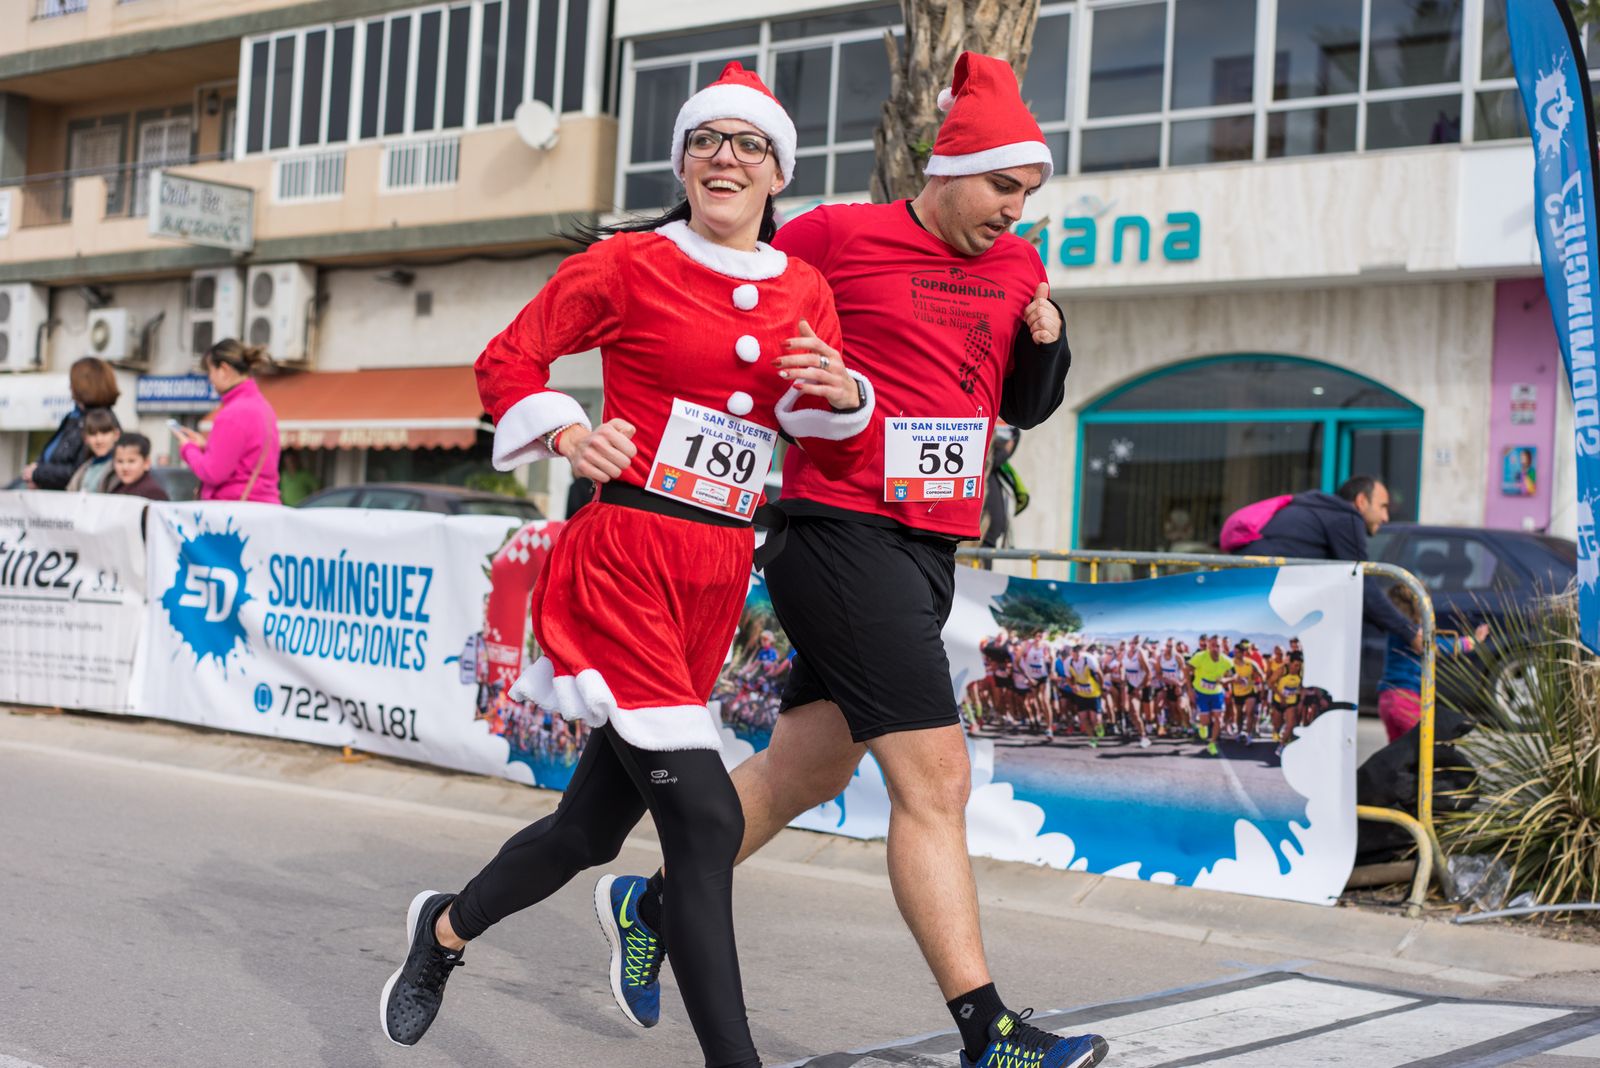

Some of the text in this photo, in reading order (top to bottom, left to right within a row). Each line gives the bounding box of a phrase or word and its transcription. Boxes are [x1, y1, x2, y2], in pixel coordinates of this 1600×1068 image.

[912, 310, 935, 324] Villa
[936, 315, 947, 326] de
[930, 303, 947, 315] San
[949, 305, 990, 320] Silvestre
[685, 406, 773, 442] VII SAN SILVESTRE
[701, 425, 723, 439] VILLA
[725, 434, 735, 443] DE
[892, 422, 984, 431] VII SAN SILVESTRE
[684, 434, 757, 485] 189
[918, 442, 964, 475] 58
[178, 562, 239, 623] SD
[268, 549, 434, 623] SDOMÍNGUEZ
[263, 612, 429, 672] PRODUCCIONES
[997, 1014, 1011, 1031] NIKE
